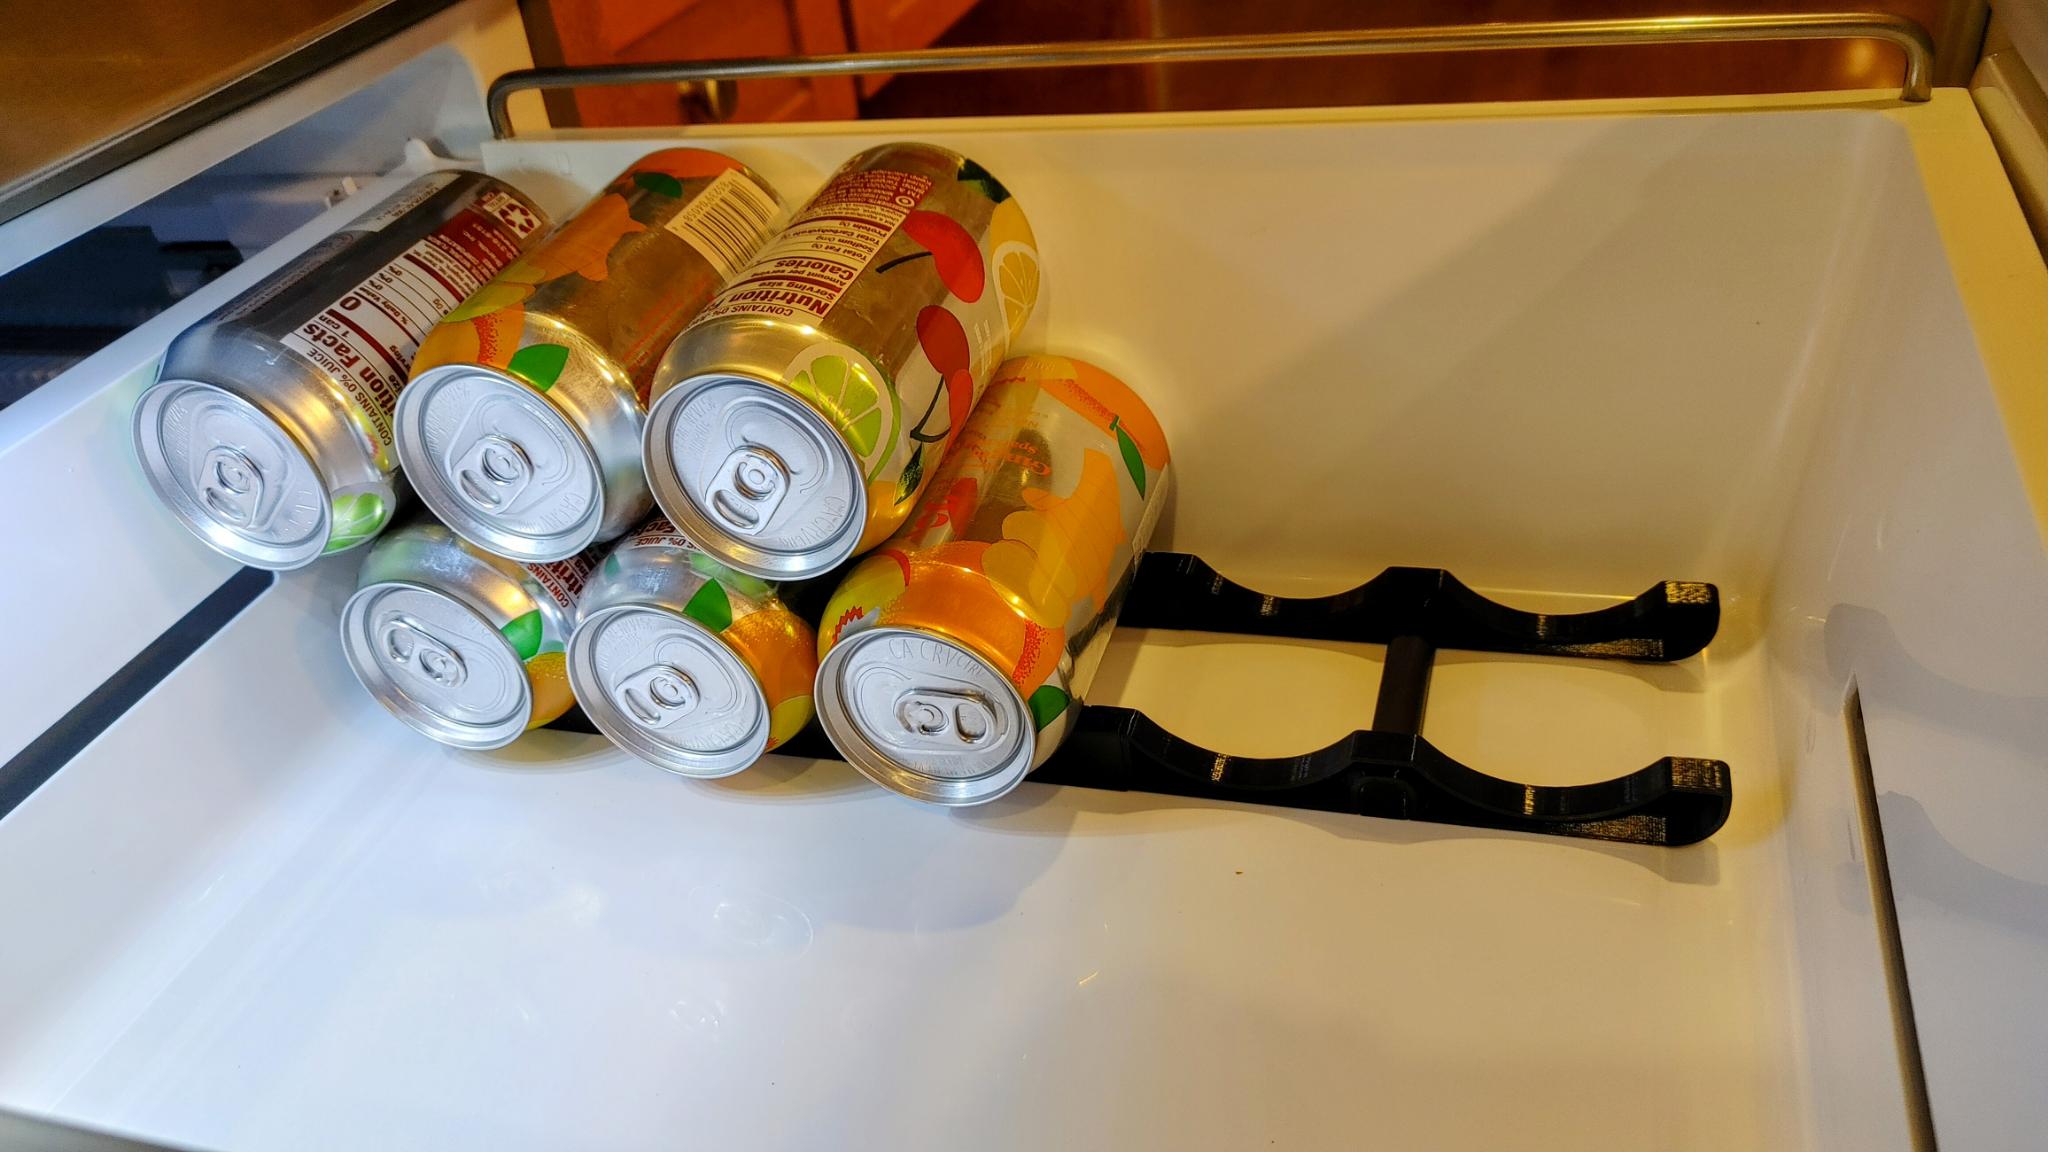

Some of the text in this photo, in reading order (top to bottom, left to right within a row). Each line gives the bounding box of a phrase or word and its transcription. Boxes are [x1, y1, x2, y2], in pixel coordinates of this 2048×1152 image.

[793, 228, 853, 236] Carbohydrate
[852, 224, 887, 237] Protein
[856, 233, 880, 245] Total
[816, 235, 874, 252] Sodium 0mg
[843, 249, 867, 260] Total
[377, 272, 393, 284] 0%
[774, 260, 853, 280] Calories
[806, 271, 846, 286] Amount
[359, 286, 382, 302] Value
[368, 279, 383, 292] 0%
[388, 265, 444, 310] 0g 0%
[786, 281, 836, 300] Serving
[339, 293, 363, 314] 0
[381, 301, 401, 318] Daily
[729, 292, 829, 315] Nutrition
[732, 305, 793, 316] CONTAINS
[318, 314, 403, 393] ize 1 can
[301, 321, 396, 416] ition Facts
[306, 348, 392, 447] CONTAINS 0% JUICE
[635, 538, 686, 546] 0% JUICE
[526, 562, 570, 608] CONTAINS
[890, 638, 913, 659] CA
